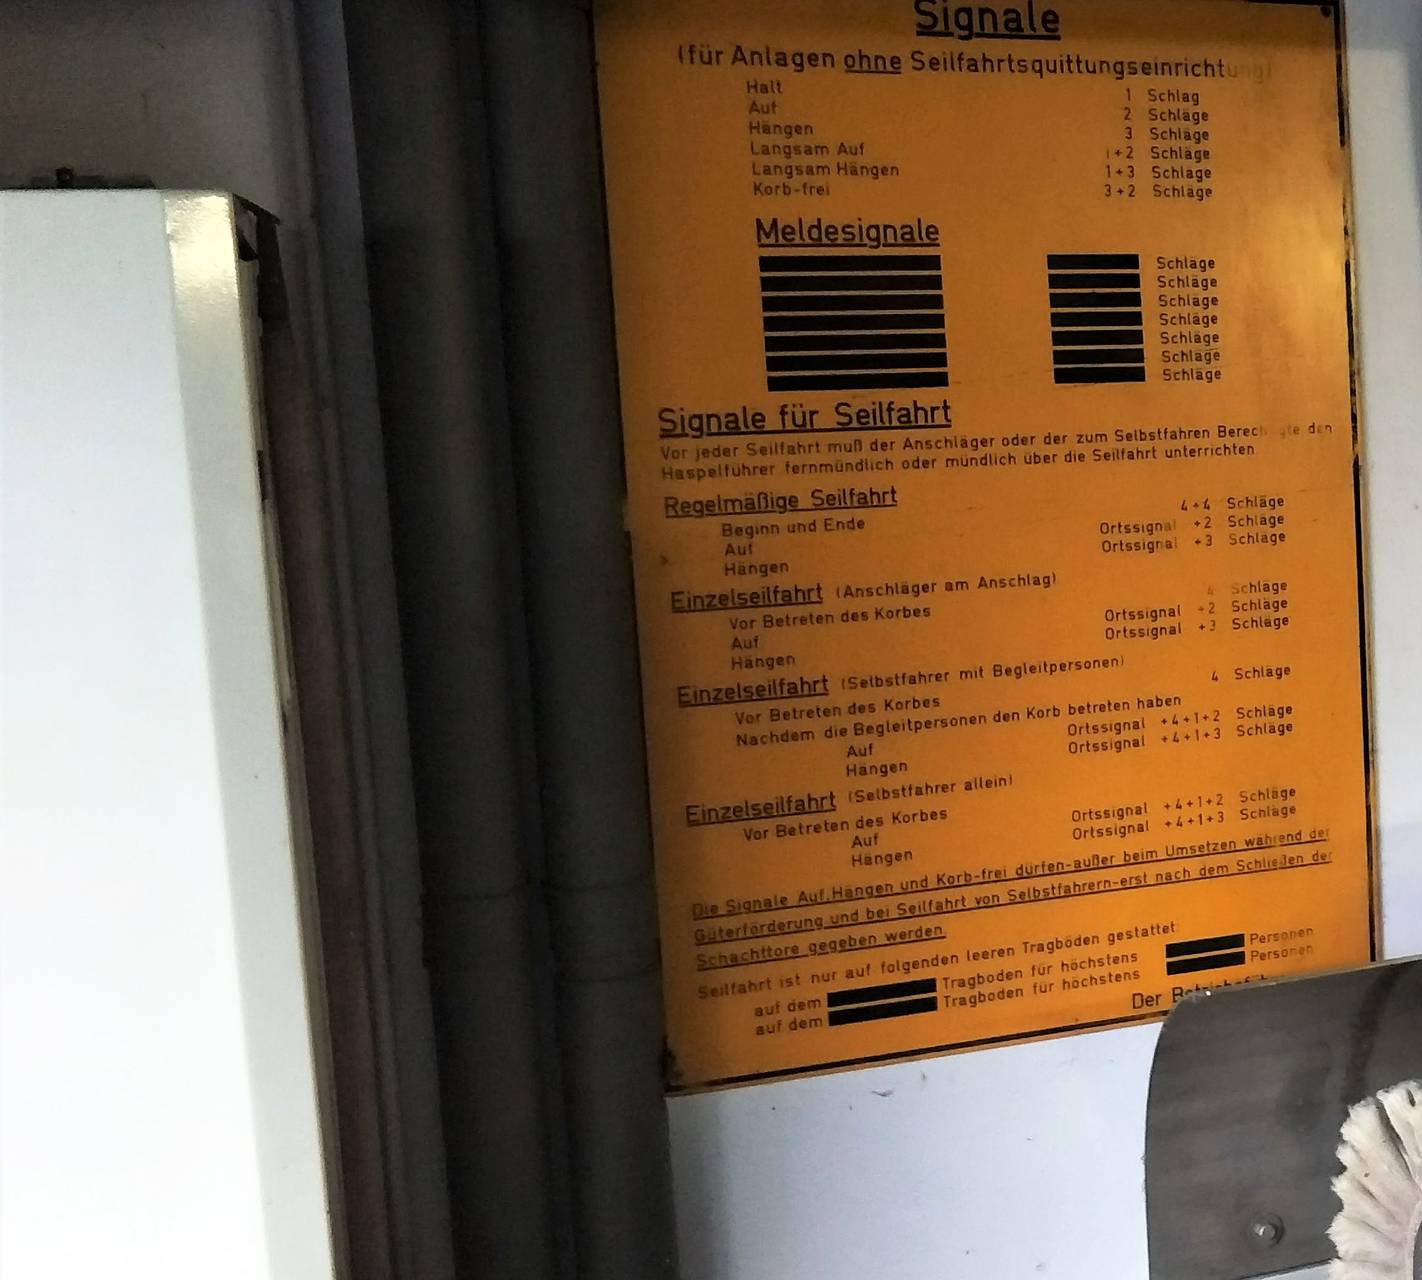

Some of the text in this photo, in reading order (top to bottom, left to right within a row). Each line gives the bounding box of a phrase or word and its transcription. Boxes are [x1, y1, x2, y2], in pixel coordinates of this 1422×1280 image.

[914, 0, 1062, 41] Signale
[731, 45, 836, 73] Anlagen
[844, 49, 902, 75] ohne
[746, 80, 1199, 105] Halt 1 Schlag
[749, 100, 778, 115] Auf
[1124, 107, 1132, 121] 2
[1125, 126, 1133, 140] 3
[750, 141, 830, 160] Langsam
[837, 142, 864, 157] Auf
[752, 162, 831, 180] Langsam
[753, 182, 830, 197] Korb-frei
[755, 217, 941, 249] Meldesignale
[658, 399, 952, 440] Signale für Seilfahrt
[660, 447, 688, 460] Vor
[746, 441, 821, 457] Seilfahrt
[827, 439, 863, 453] muß
[869, 438, 896, 452] der
[902, 435, 995, 451] Anschläger
[1002, 434, 1036, 447] oder
[1043, 433, 1068, 445] der
[1076, 433, 1108, 444] zum
[1115, 427, 1210, 442] Selbstfahren
[785, 458, 894, 475] fernmündlich
[901, 456, 937, 470] oder
[1064, 450, 1086, 463] die
[1092, 446, 1157, 462] Seilfahrt
[1165, 443, 1255, 459] unterrichten
[664, 485, 898, 519] Regelmäßige Seilfahrt
[721, 523, 780, 540] Beginn
[787, 519, 817, 534] und
[824, 517, 865, 532] Ende
[671, 583, 824, 614] Einzelseilfahrt
[945, 581, 969, 592] am
[729, 606, 931, 630] Vor Betreten des Korbes
[730, 635, 759, 651] Auf
[1105, 604, 1181, 624] Ortssignal
[1105, 622, 1182, 641] Ortssignal
[676, 674, 830, 709] Einzelseilfahrt
[960, 666, 983, 680] mit
[735, 712, 762, 725] Vor
[769, 705, 842, 722] Betreten
[847, 702, 876, 715] des
[884, 696, 940, 712] Korbes
[1212, 671, 1219, 682] 4
[736, 695, 1181, 747] Nachdem die Begleitpersonen den Korb betreten haben
[847, 743, 873, 759] Auf
[1068, 717, 1145, 736] Ortssignal
[1069, 735, 1145, 754] Ortssignal
[685, 791, 837, 828] Einzelseilfahrt
[743, 809, 947, 842] Vor Betreten des Korbes
[851, 832, 879, 849] Auf
[1072, 802, 1148, 822] Ortssignal
[1073, 820, 1149, 840] Ortssignal
[698, 935, 1100, 1000] Seilfahrt nur auf folgenden leeren Tragböden
[754, 1001, 780, 1017] auf
[787, 999, 821, 1013] dem
[942, 969, 1023, 990] Tragboden
[1132, 993, 1162, 1009] Der
[756, 1020, 782, 1036] auf
[788, 1017, 823, 1031] dem
[944, 988, 1024, 1008] Tragboden
